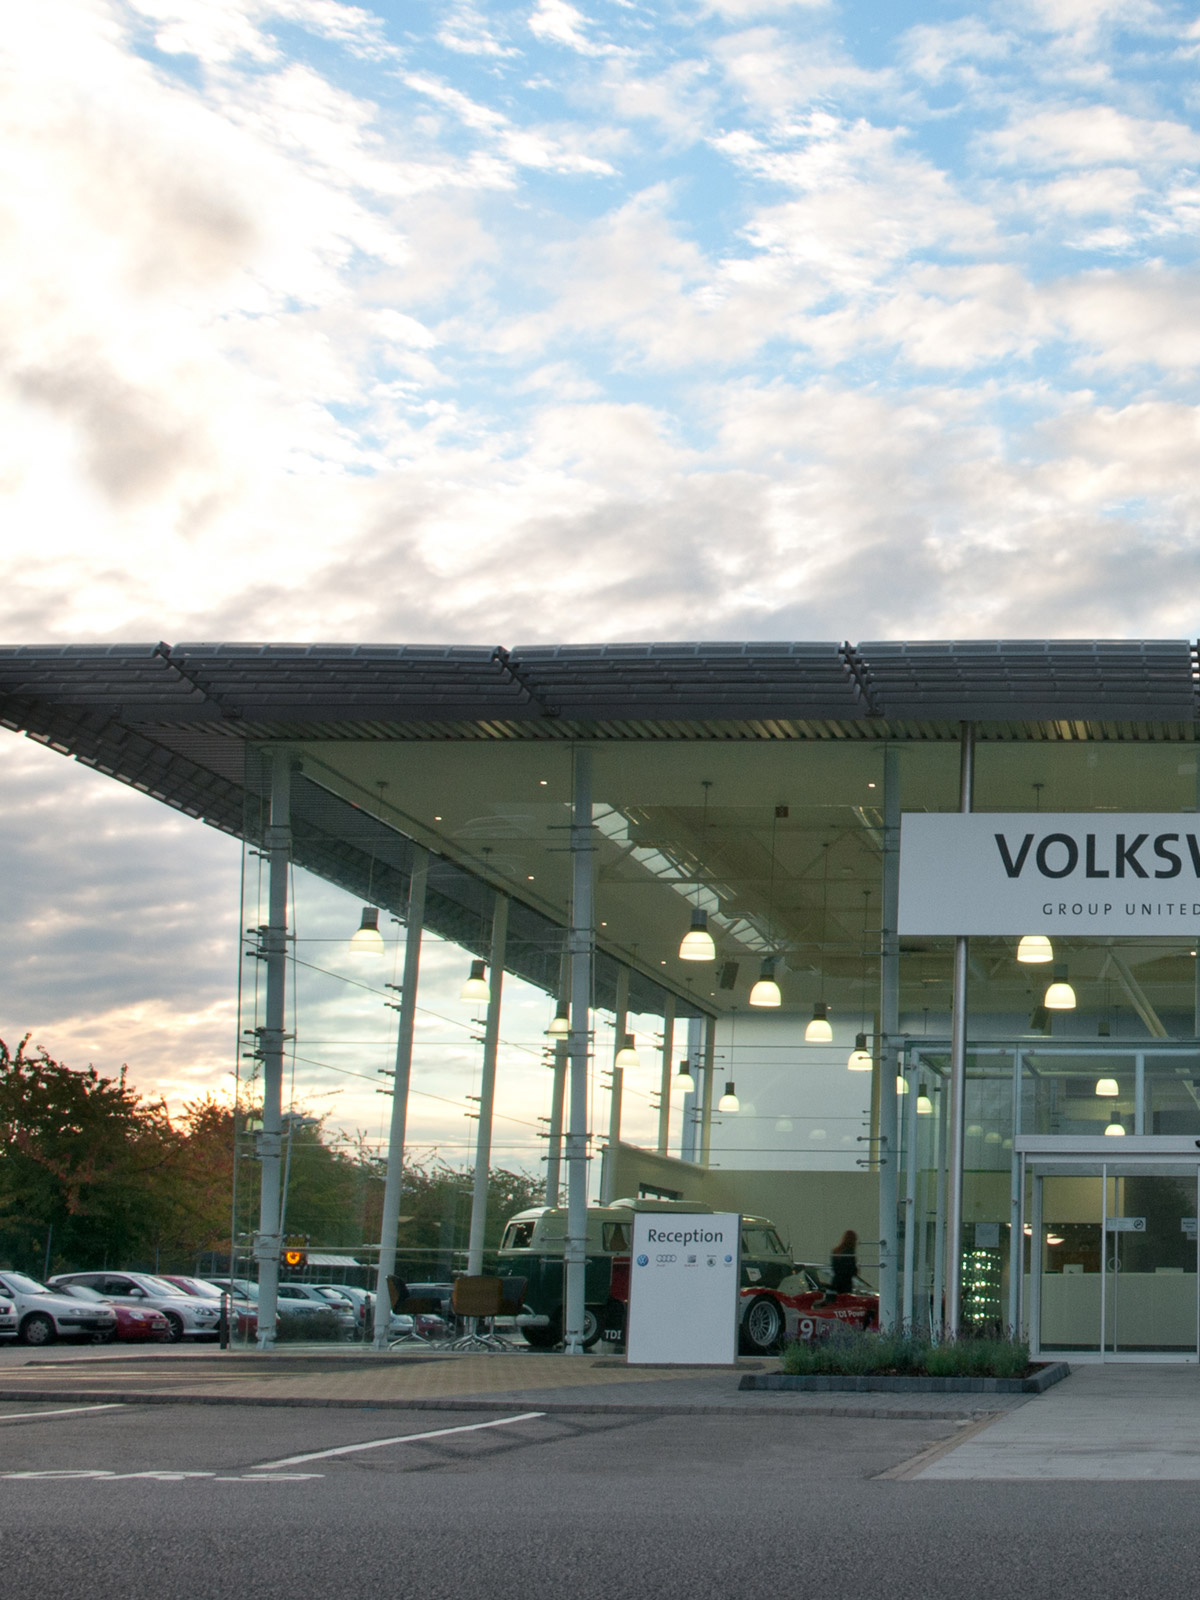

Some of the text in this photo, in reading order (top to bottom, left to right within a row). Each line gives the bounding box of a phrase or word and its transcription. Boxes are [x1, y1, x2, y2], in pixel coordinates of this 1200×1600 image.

[1043, 904, 1111, 915] GROUP
[649, 1229, 722, 1246] Reception
[833, 1310, 847, 1318] TDI
[604, 1329, 622, 1340] TDI
[800, 1319, 814, 1339] 9
[0, 1470, 326, 1481] ORS
